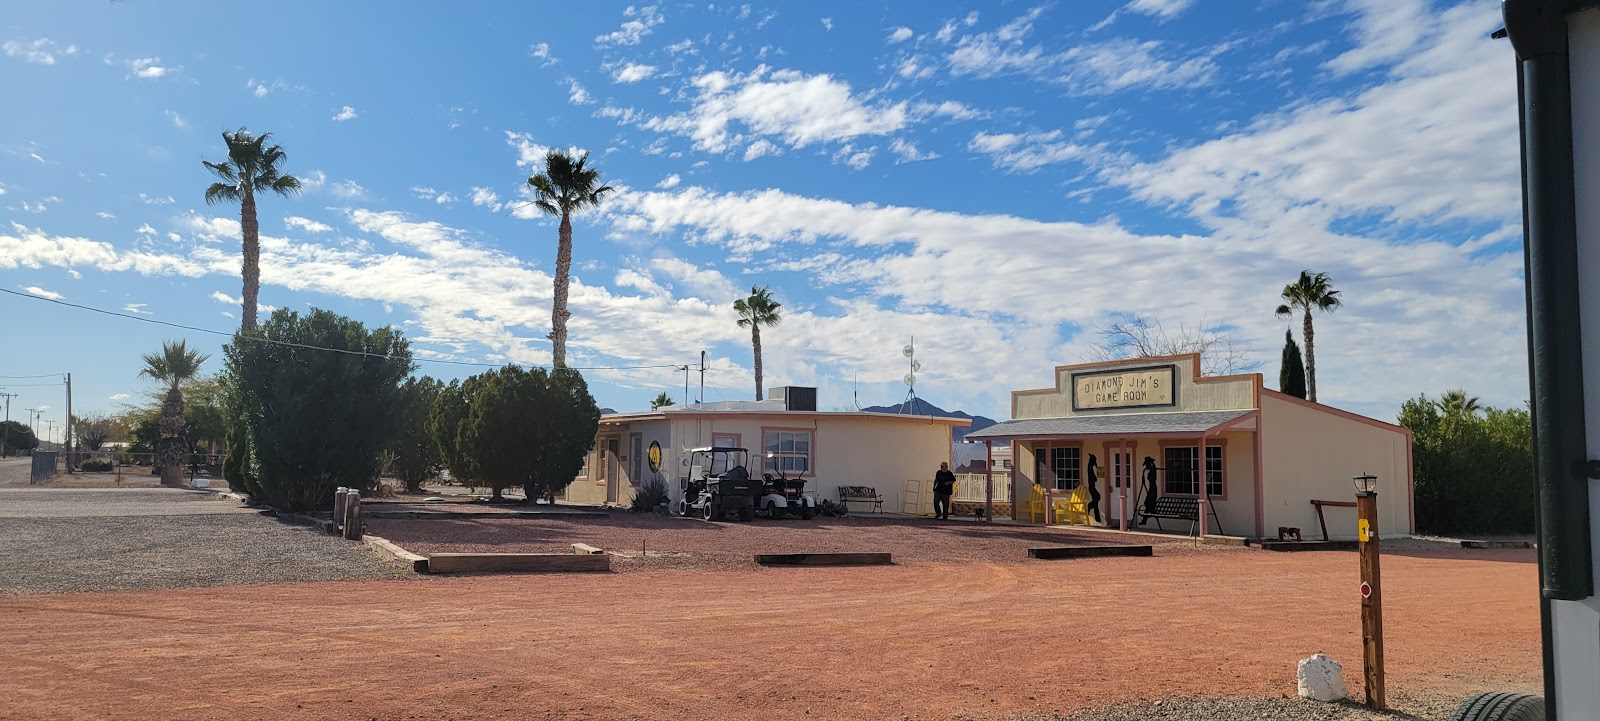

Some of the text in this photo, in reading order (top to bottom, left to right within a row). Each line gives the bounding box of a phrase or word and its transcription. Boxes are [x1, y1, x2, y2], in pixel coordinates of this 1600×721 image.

[1085, 376, 1159, 393] DIAMOND JIM'S
[1096, 391, 1147, 403] GAME ROOM
